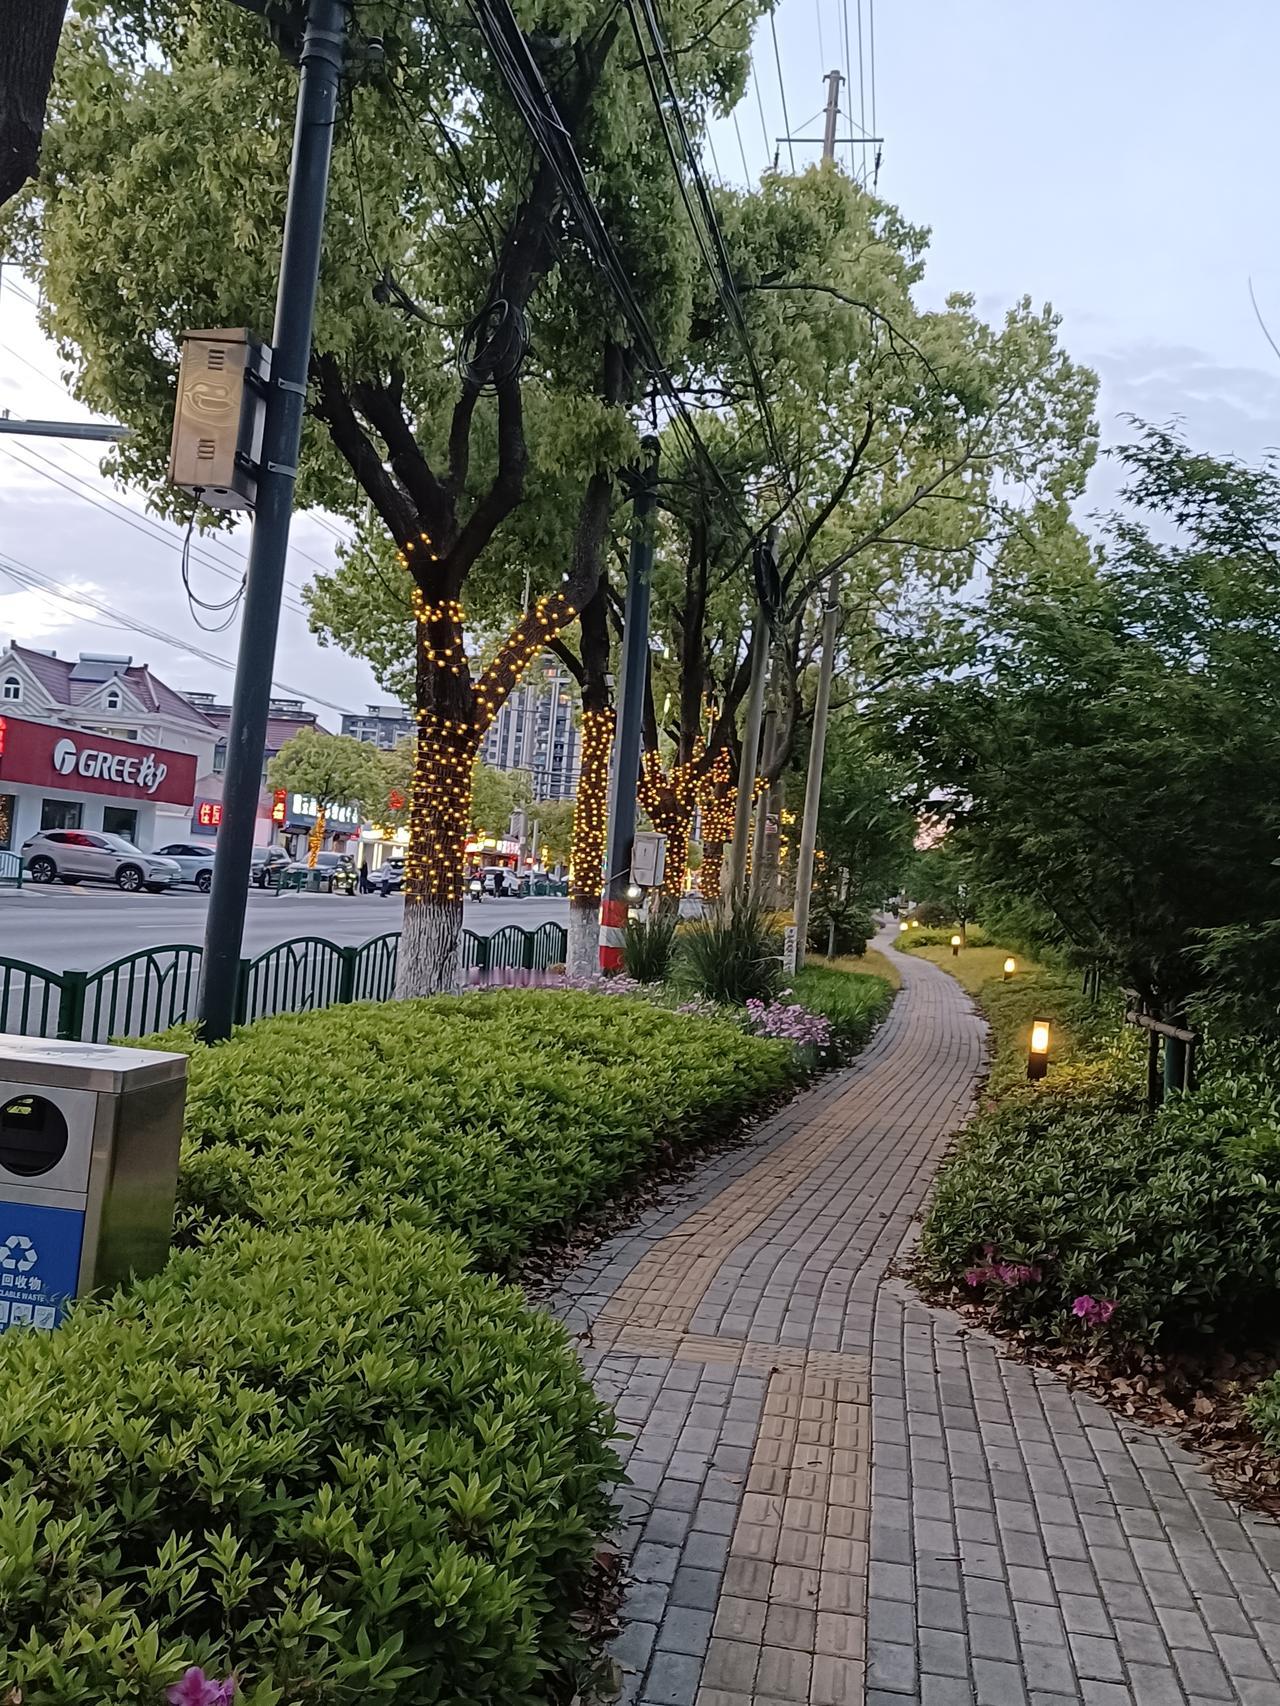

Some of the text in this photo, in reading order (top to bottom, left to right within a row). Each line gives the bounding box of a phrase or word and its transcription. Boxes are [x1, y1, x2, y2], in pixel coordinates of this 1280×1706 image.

[79, 749, 139, 784] GREE
[0, 1272, 41, 1291] 回收物
[22, 1292, 45, 1302] WASTE
